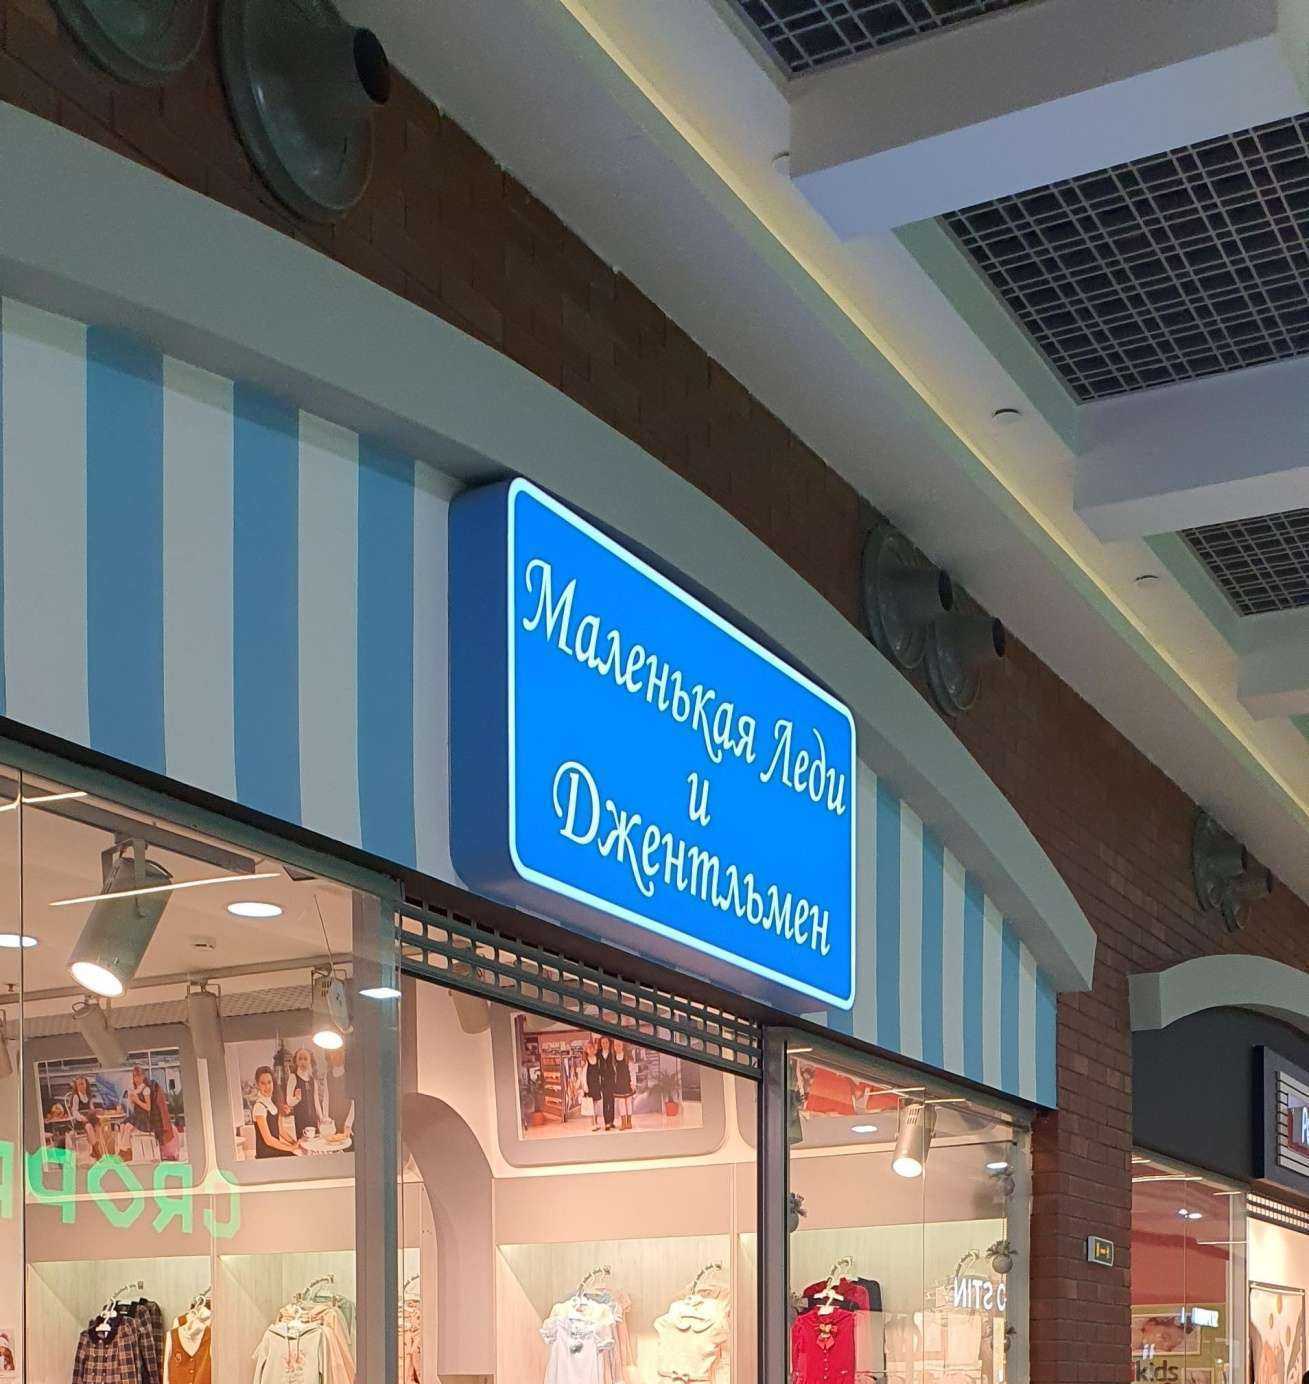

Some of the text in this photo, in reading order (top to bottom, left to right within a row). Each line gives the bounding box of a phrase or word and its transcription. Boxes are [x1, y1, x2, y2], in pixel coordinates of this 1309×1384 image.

[522, 558, 846, 816] Маленькая Леди
[553, 760, 831, 957] Джентльмен
[687, 772, 711, 827] и
[1135, 1360, 1179, 1382] kids
